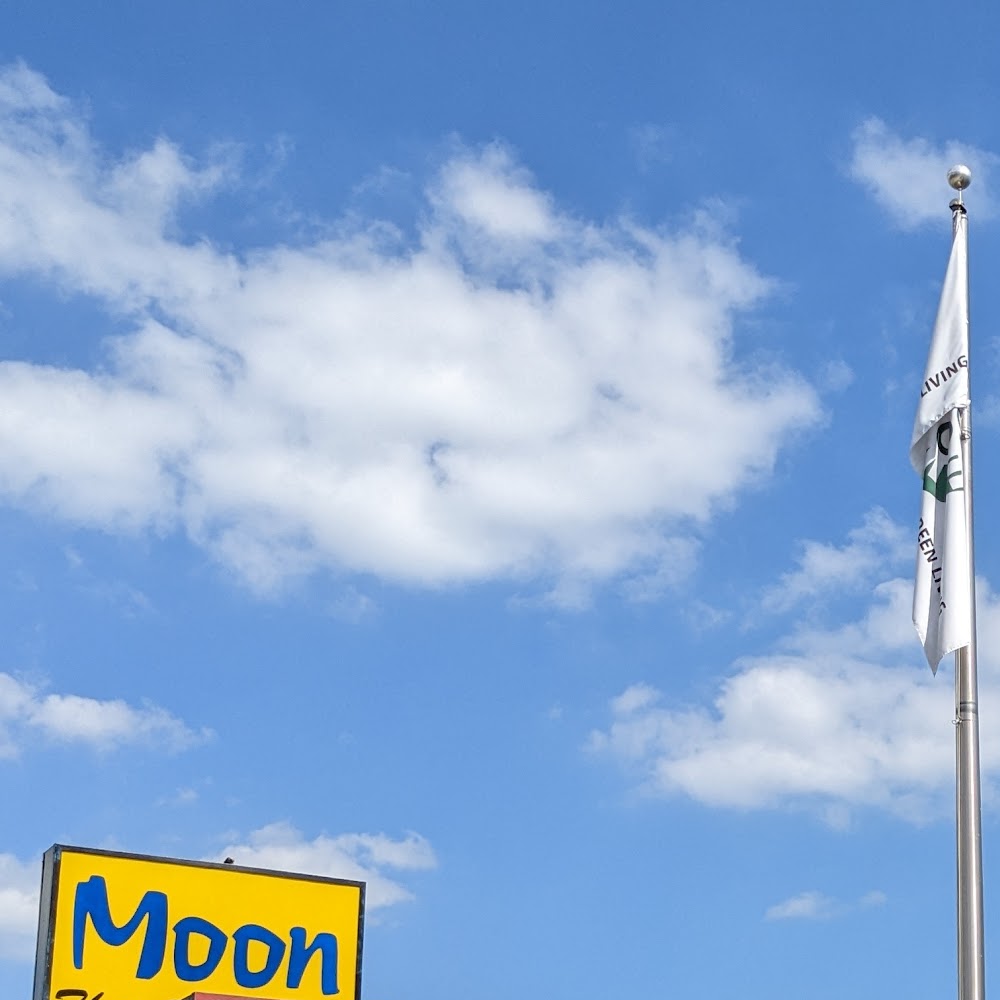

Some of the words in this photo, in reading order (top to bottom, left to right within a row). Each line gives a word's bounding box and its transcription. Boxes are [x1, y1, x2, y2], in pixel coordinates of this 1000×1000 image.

[920, 354, 969, 398] LIVING
[917, 517, 938, 563] EEN
[73, 875, 340, 996] Moon
